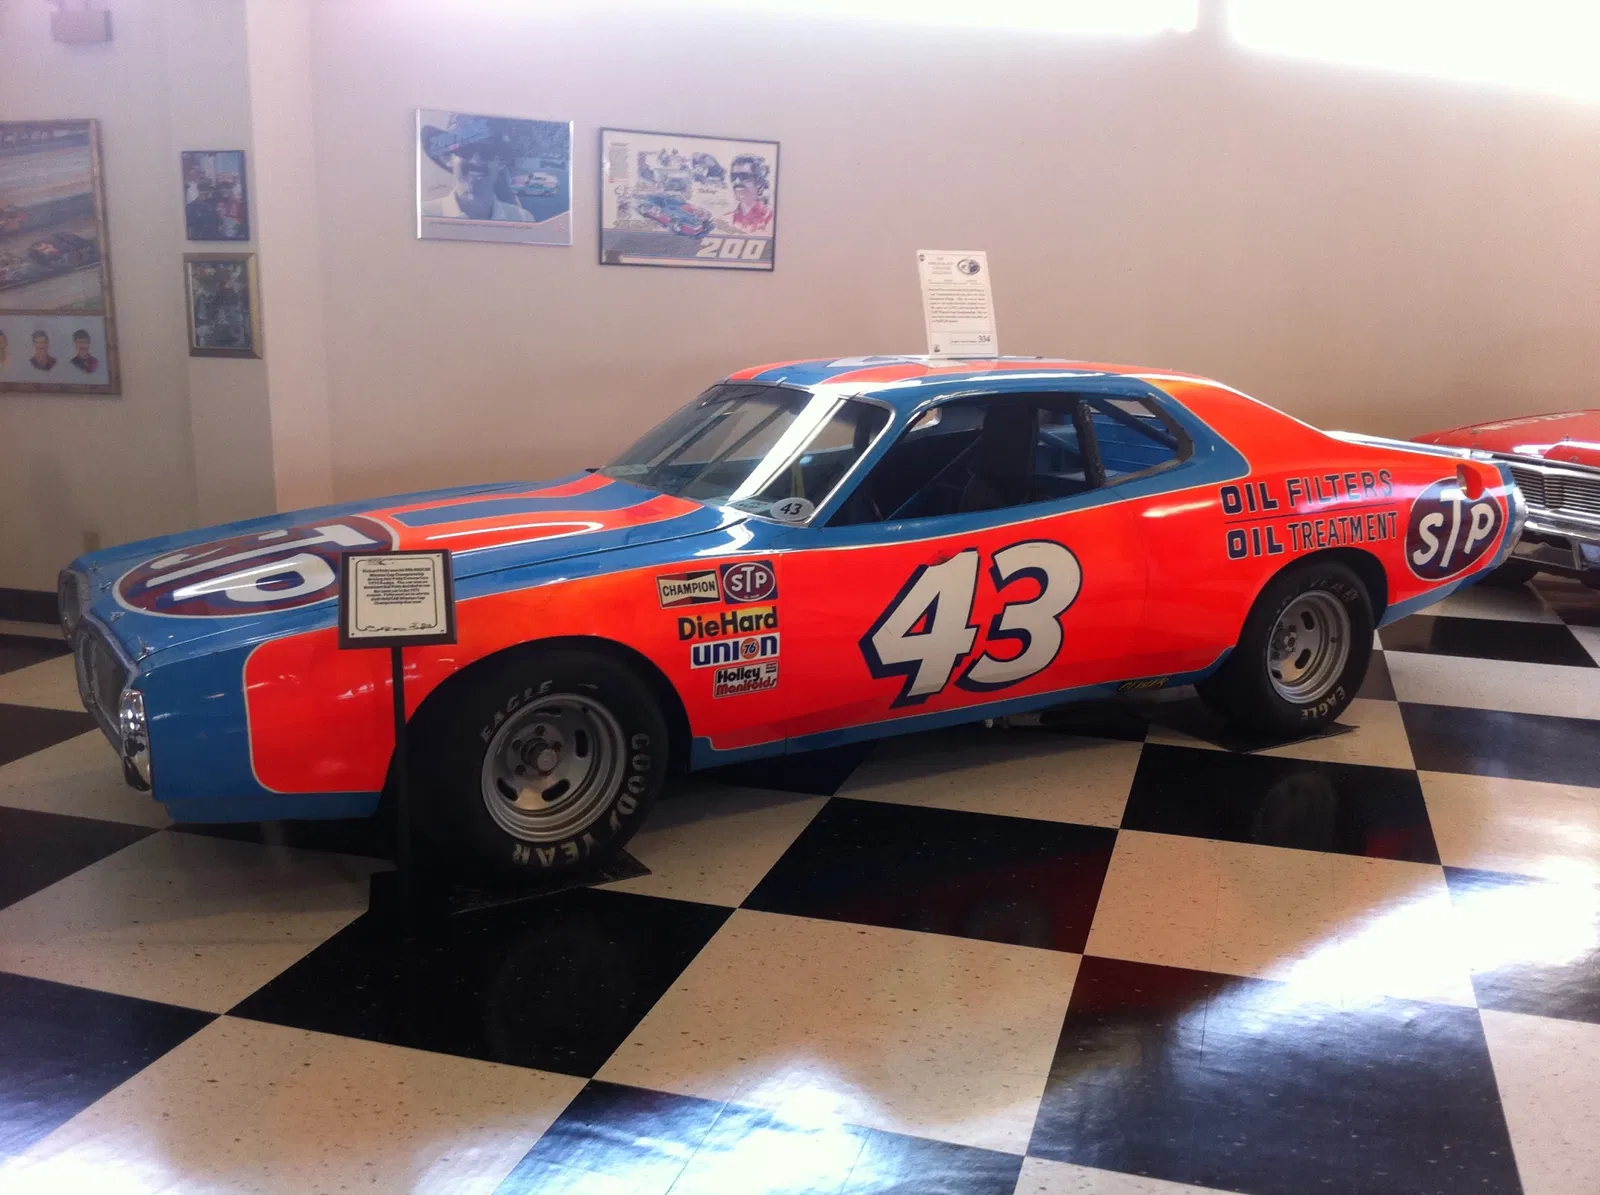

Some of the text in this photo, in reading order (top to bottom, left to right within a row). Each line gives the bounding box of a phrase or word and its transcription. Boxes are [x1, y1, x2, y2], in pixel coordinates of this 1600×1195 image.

[695, 236, 768, 260] 200
[1220, 469, 1394, 515] OIL FILTERS
[780, 503, 803, 515] 43
[1226, 510, 1399, 560] OIL TREATMENT
[1412, 488, 1495, 568] STP
[662, 581, 716, 597] CHAMPION
[731, 566, 769, 593] STP
[678, 606, 779, 641] DieHard
[858, 538, 1084, 710] 43
[715, 676, 777, 696] Manifolds
[716, 666, 762, 684] Holley
[480, 679, 553, 743] EAGLE
